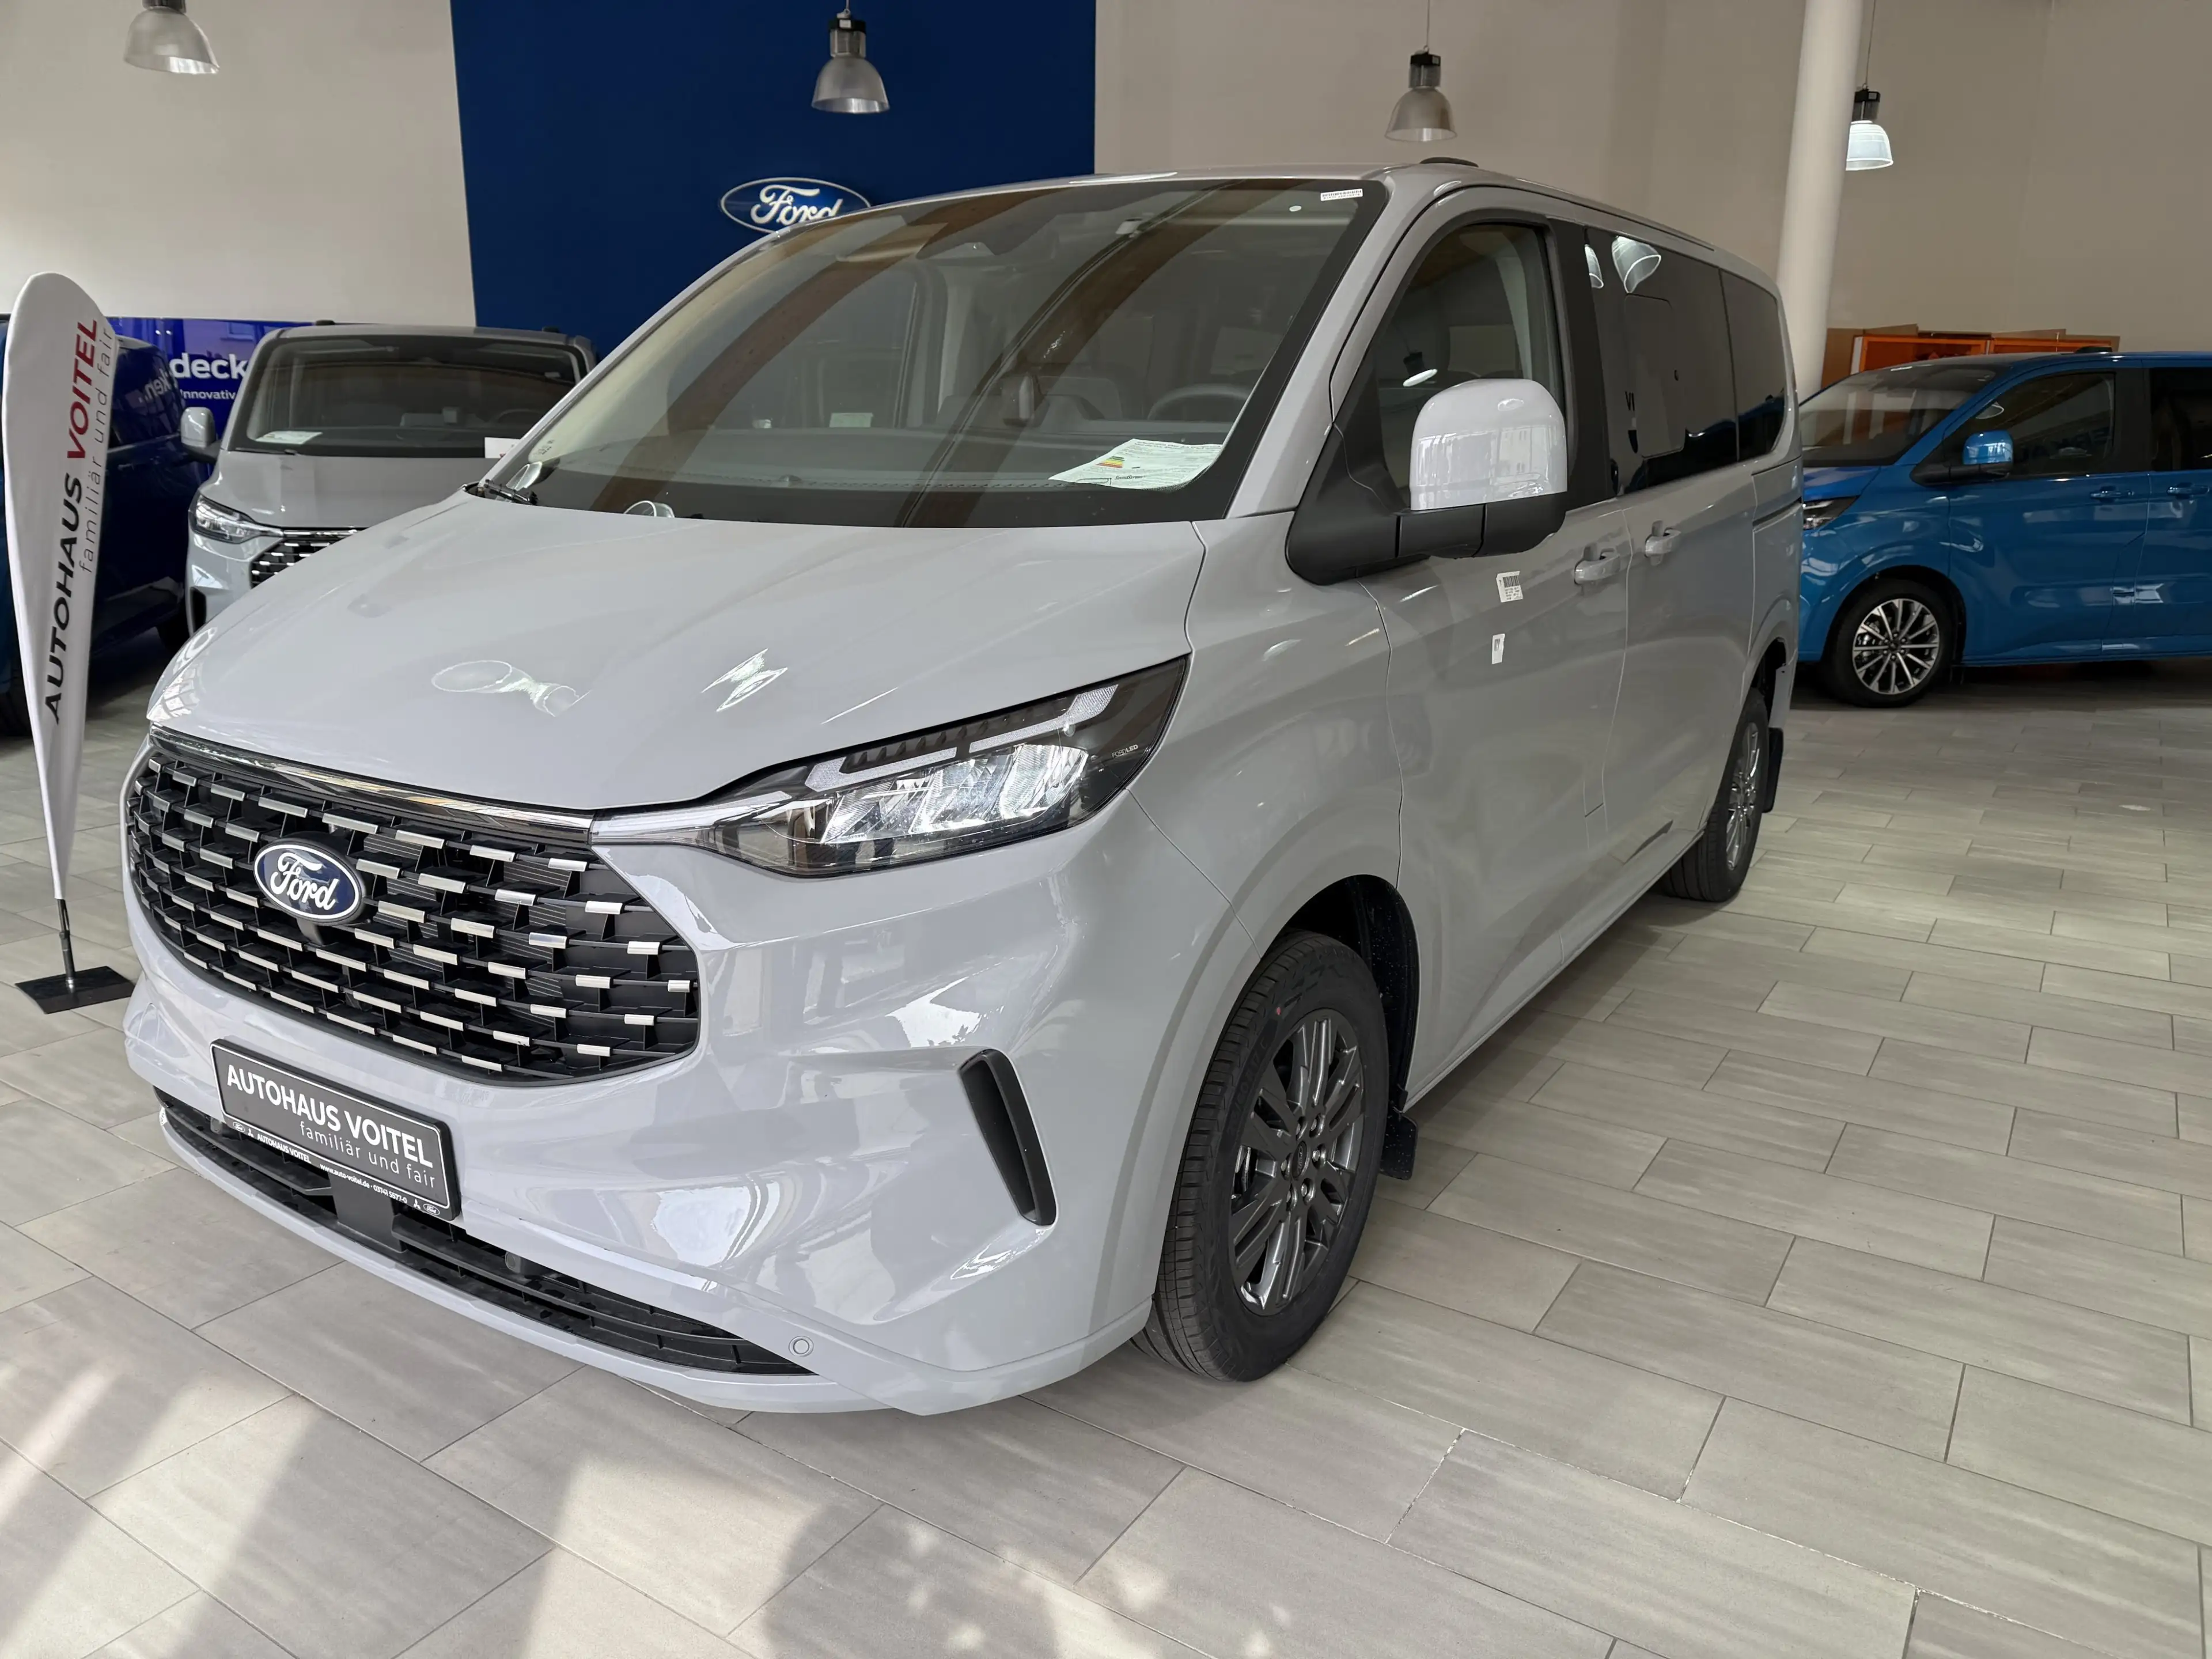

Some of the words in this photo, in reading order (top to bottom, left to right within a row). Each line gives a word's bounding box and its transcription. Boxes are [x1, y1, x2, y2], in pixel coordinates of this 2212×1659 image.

[751, 184, 843, 226] Ford
[97, 327, 112, 378] fair
[94, 387, 108, 444] und
[44, 472, 82, 725] AUTOHAUS
[67, 319, 97, 459] VOITEL
[79, 456, 102, 573] familiär
[270, 851, 339, 911] Ford
[227, 1065, 340, 1132] AUTOHAUS
[344, 1110, 433, 1168] VOITEL
[257, 1133, 290, 1153] AUTOHAUS
[289, 1147, 312, 1165] VOITEL
[300, 1120, 361, 1158] familiär
[369, 1152, 400, 1175] und
[406, 1163, 435, 1188] fair
